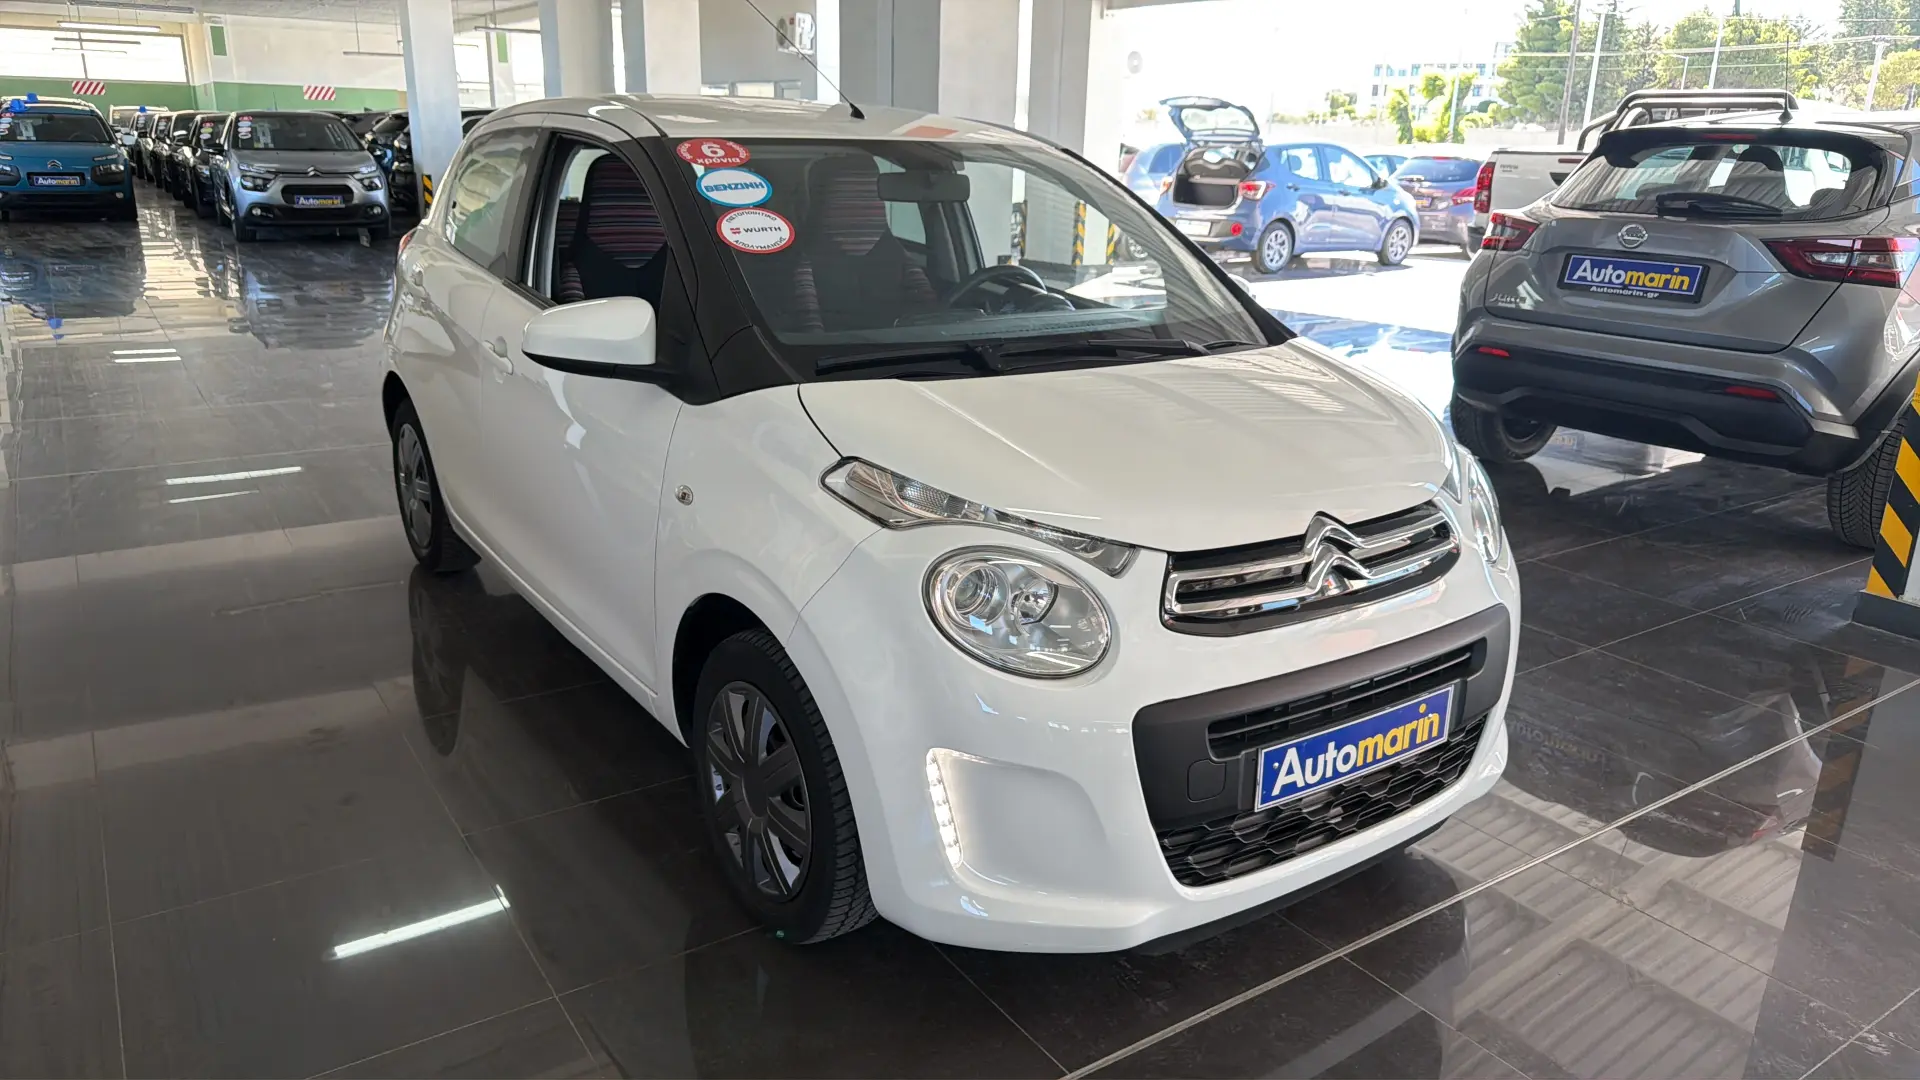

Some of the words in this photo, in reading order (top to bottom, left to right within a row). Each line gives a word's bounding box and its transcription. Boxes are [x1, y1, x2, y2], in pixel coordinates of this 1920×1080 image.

[701, 143, 725, 157] 6
[1572, 259, 1690, 291] Automarin
[1589, 285, 1660, 299] Automarin.gr
[1271, 703, 1440, 797] Automarin
